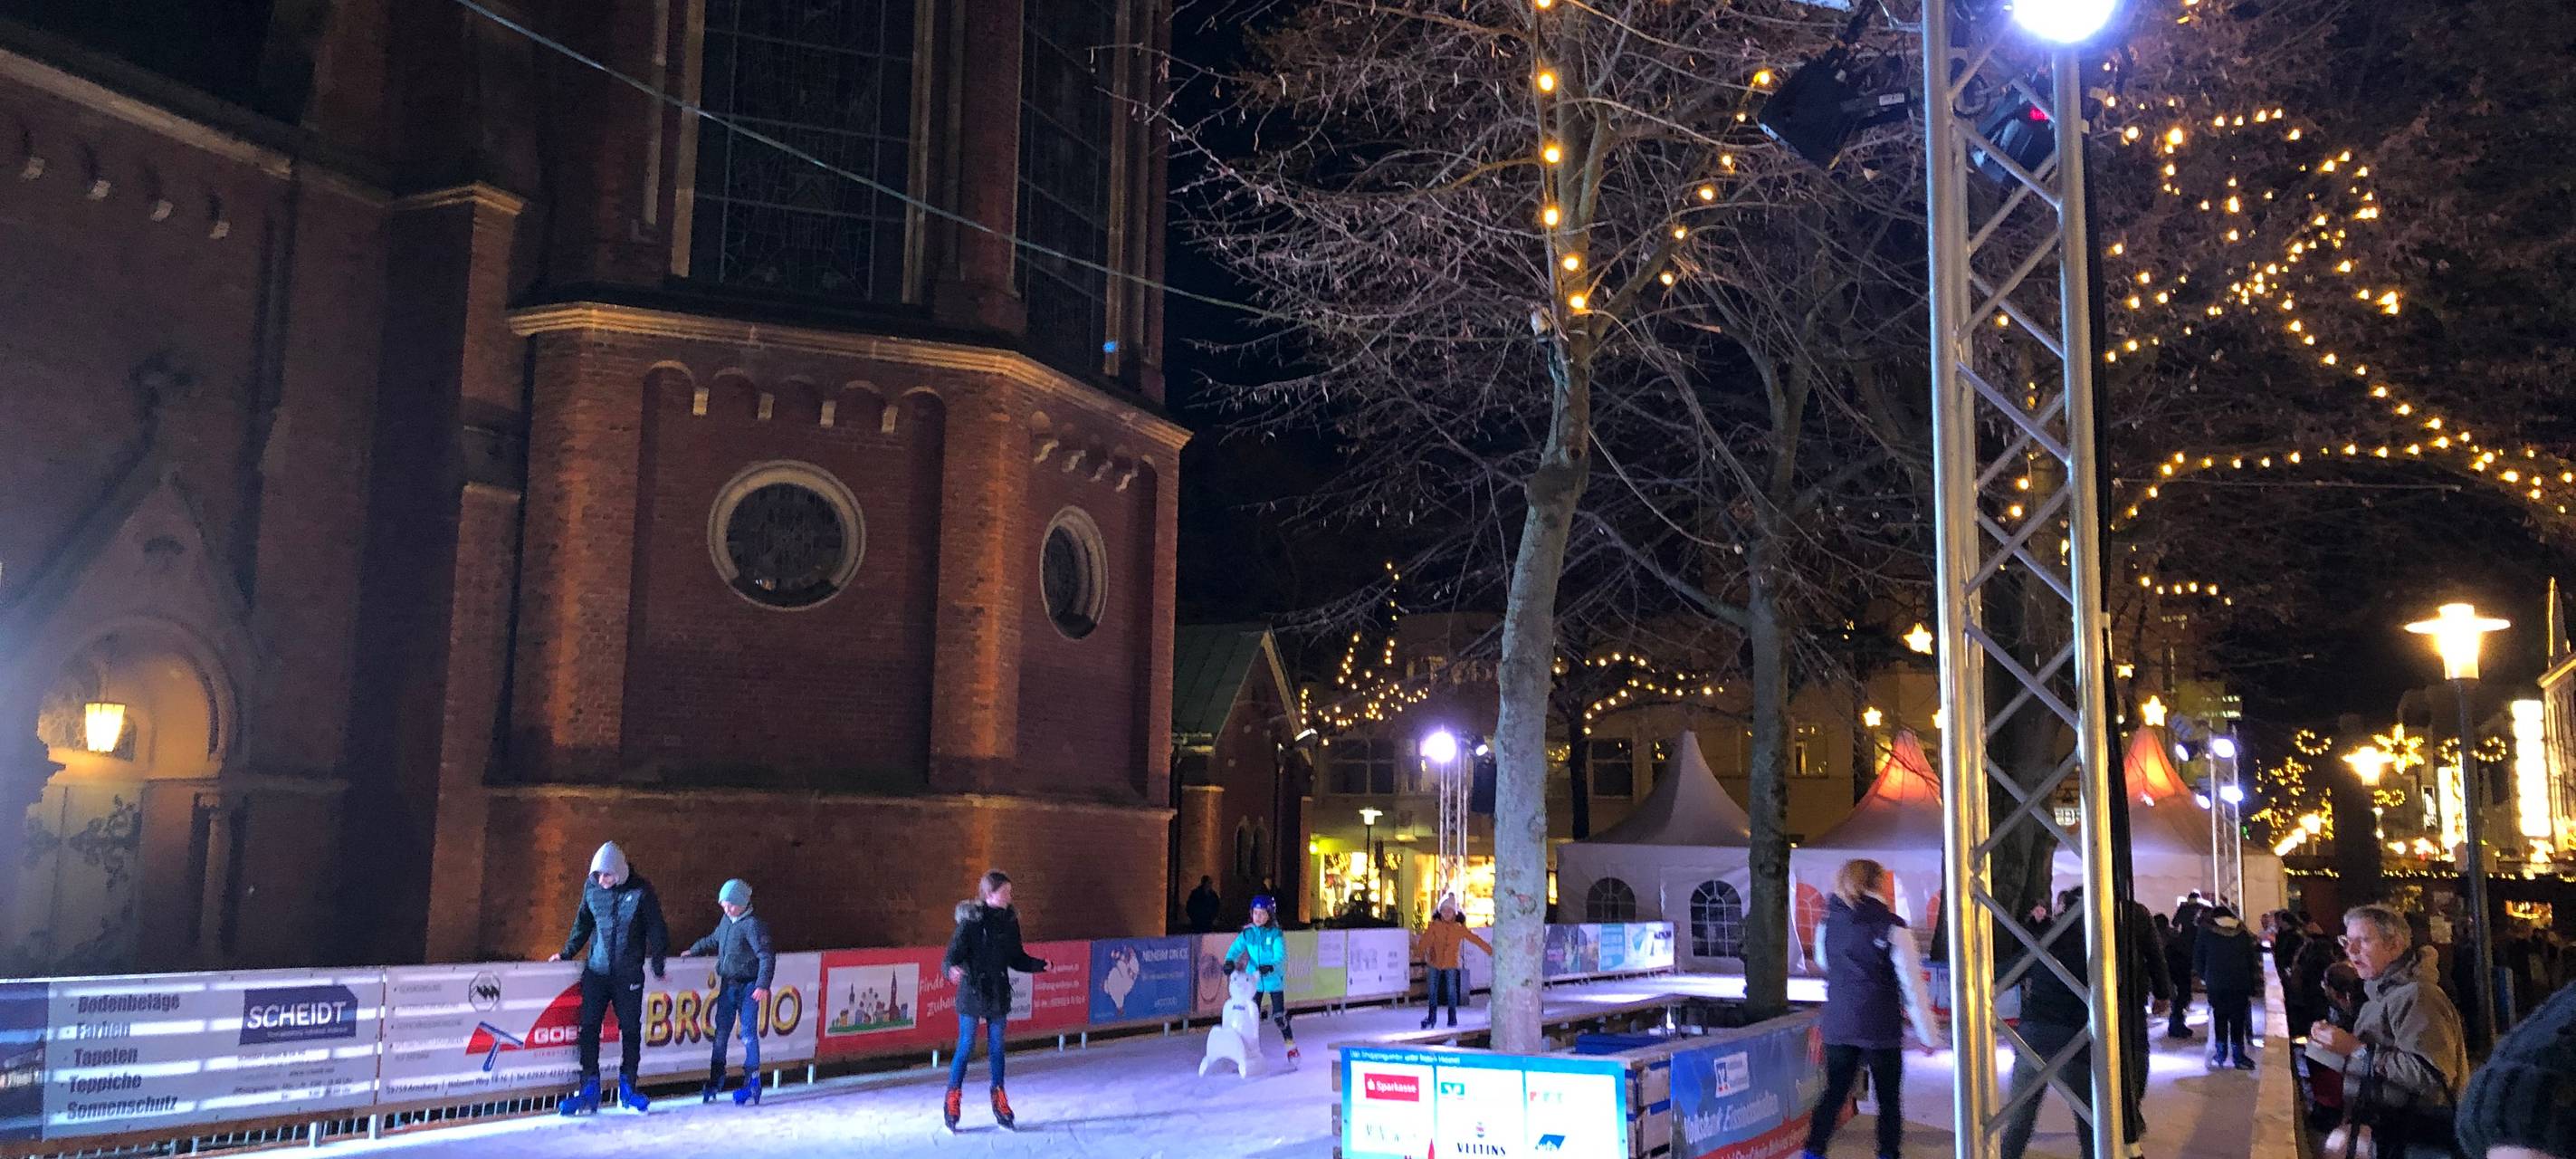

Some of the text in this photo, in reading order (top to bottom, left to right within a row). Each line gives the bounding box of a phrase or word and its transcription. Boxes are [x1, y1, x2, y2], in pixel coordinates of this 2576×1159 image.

[920, 973, 944, 993] Finde
[78, 993, 180, 1013] Bodenbeläge
[927, 995, 956, 1018] Zuhau
[247, 1001, 346, 1030] SCHEIDT
[74, 1048, 138, 1068] Tapeten
[69, 1072, 142, 1094] Teppiche
[1376, 1080, 1417, 1094] Sparkasse
[67, 1096, 178, 1120] Sonnenschutz
